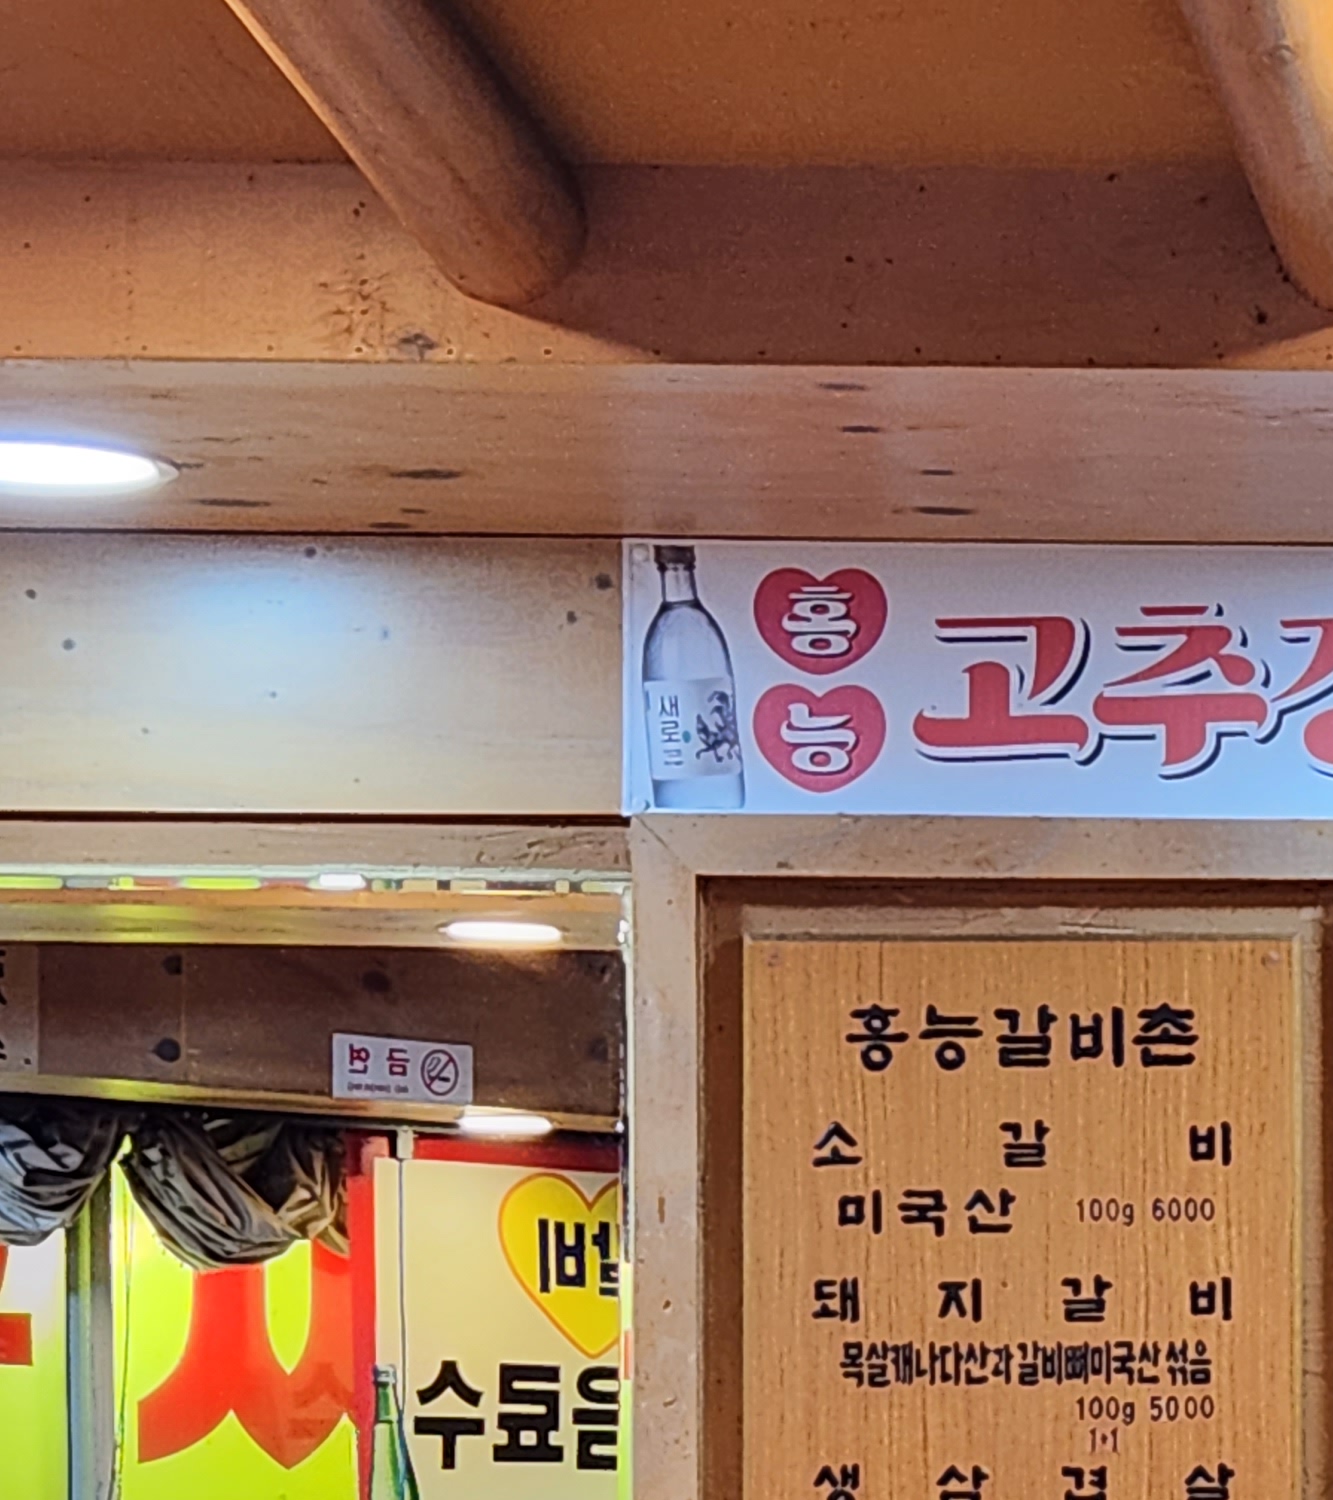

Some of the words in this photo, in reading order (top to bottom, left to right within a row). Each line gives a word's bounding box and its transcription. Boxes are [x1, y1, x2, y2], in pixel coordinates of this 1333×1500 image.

[781, 584, 858, 658] 홍
[781, 702, 858, 775] 능
[845, 1002, 1199, 1072] 홍능갈비촌
[838, 1188, 1016, 1238] 미국산
[1076, 1198, 1135, 1227] 100g
[1151, 1197, 1215, 1223] 6000
[1076, 1395, 1135, 1427] 100g
[1150, 1394, 1215, 1422] 5000
